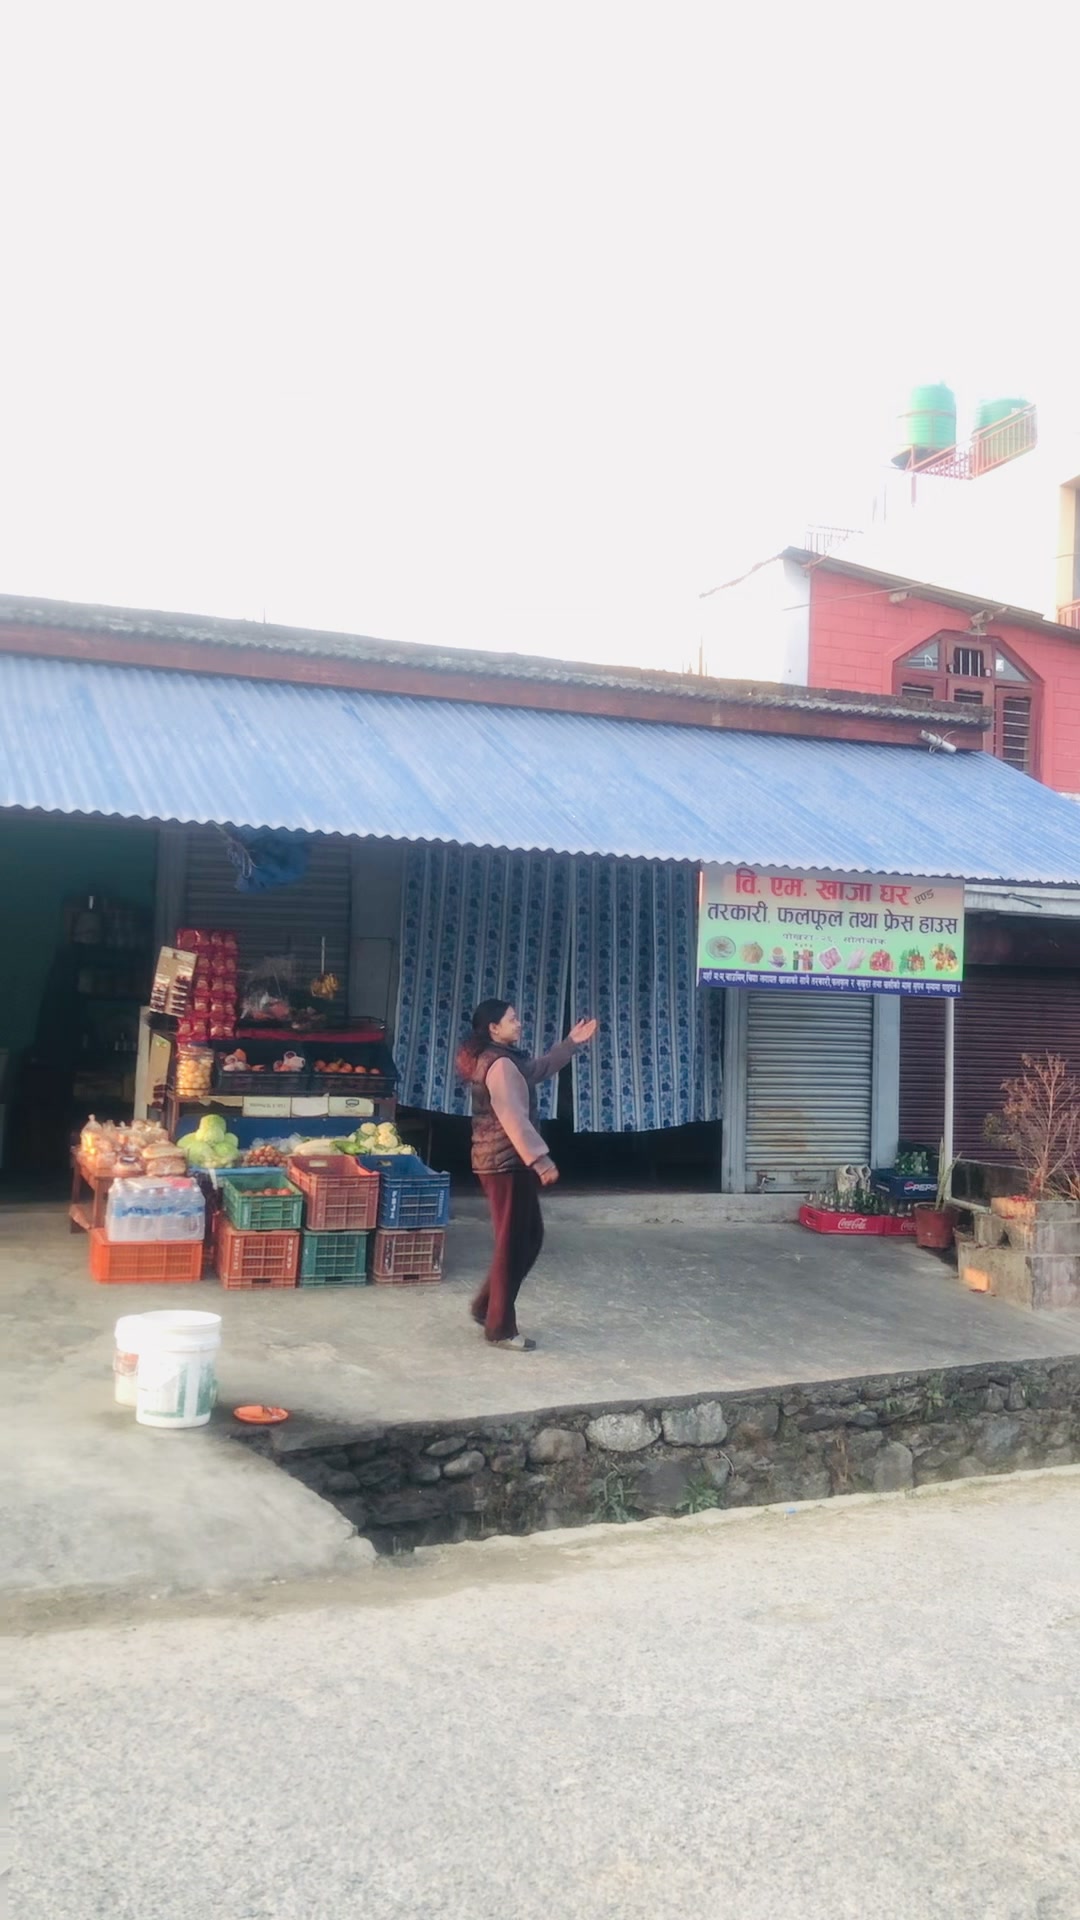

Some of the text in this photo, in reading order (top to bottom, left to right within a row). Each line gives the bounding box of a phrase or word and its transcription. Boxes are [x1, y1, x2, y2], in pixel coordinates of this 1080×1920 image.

[735, 867, 761, 895] वि.
[769, 876, 807, 897] एम.
[816, 879, 873, 902] खाजा
[879, 884, 912, 906] घर
[777, 906, 844, 930] फलफूल
[848, 911, 879, 929] तथा
[883, 908, 914, 932] फ्रेस
[919, 915, 959, 935] हाउस
[912, 1183, 938, 1192] PEPS
